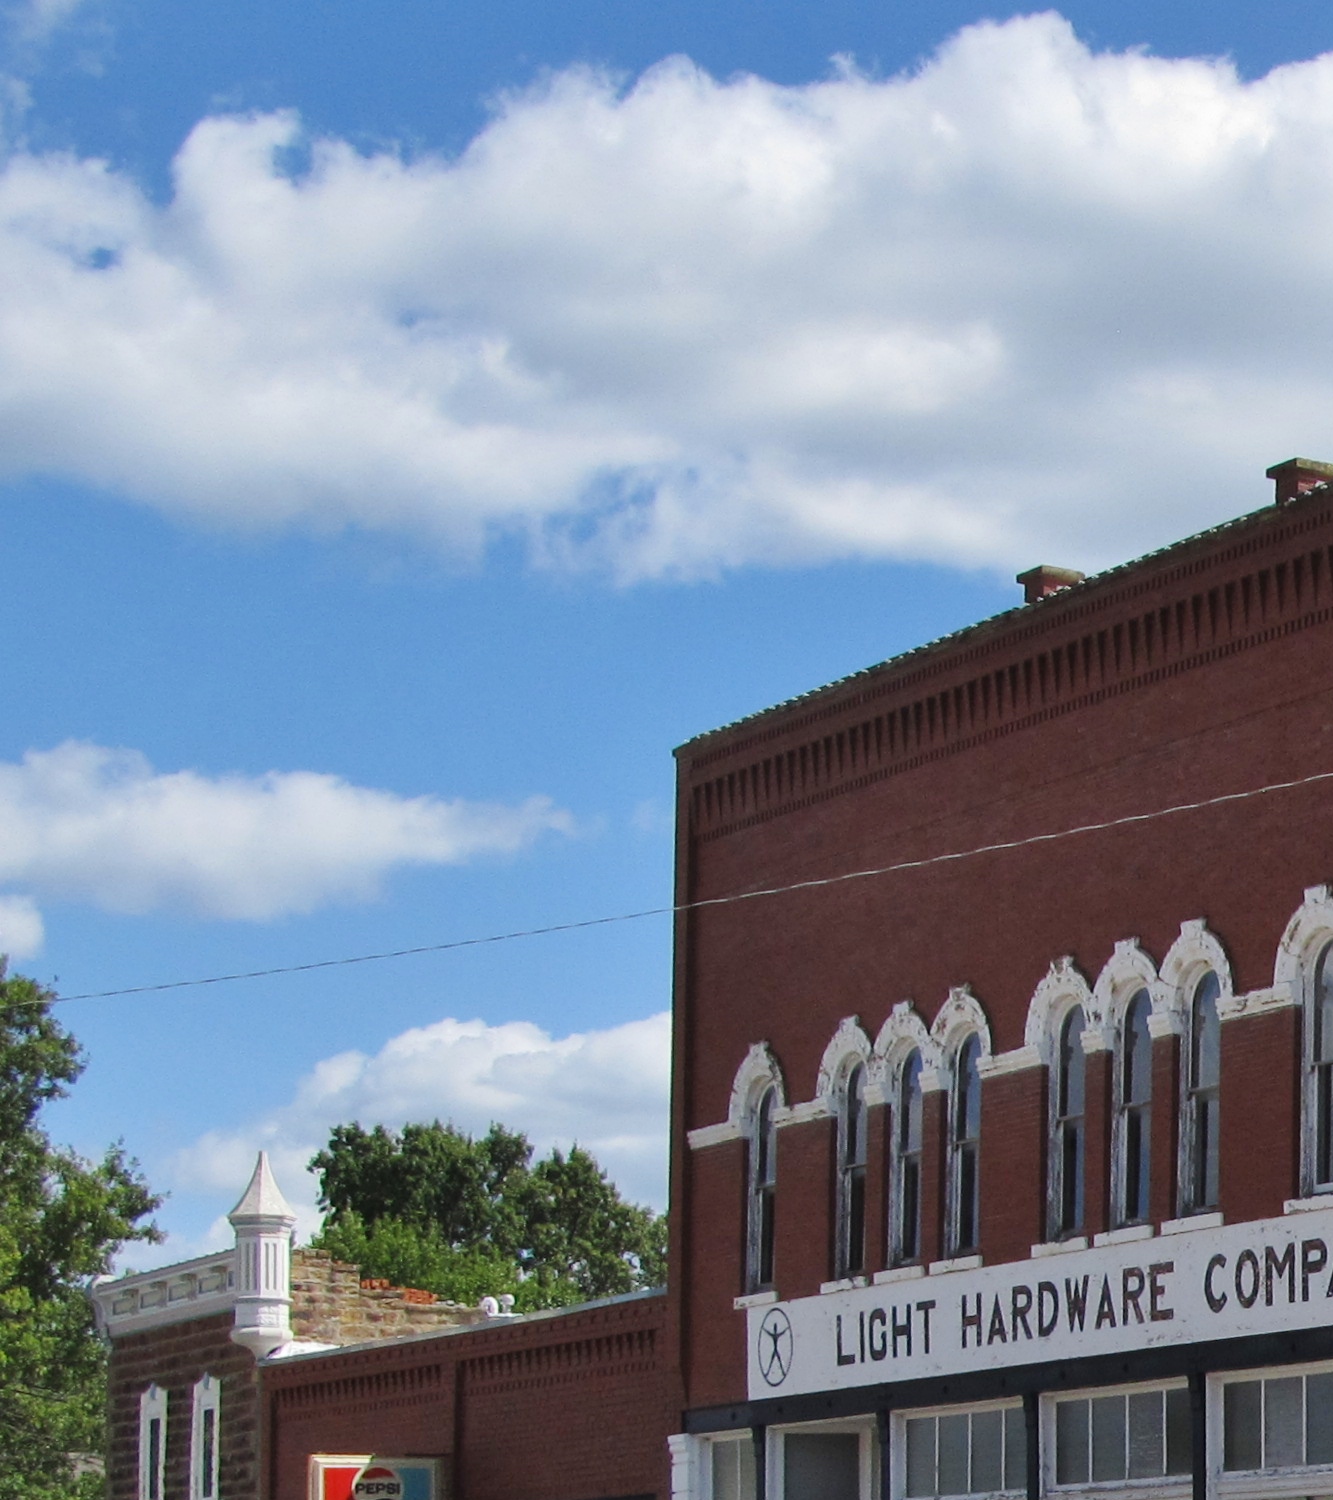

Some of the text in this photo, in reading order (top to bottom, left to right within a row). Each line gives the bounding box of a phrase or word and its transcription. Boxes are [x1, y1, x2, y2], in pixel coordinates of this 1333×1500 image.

[836, 1299, 937, 1367] LIGHT
[961, 1260, 1175, 1349] HARDWARE
[355, 1482, 401, 1495] PEPSI
